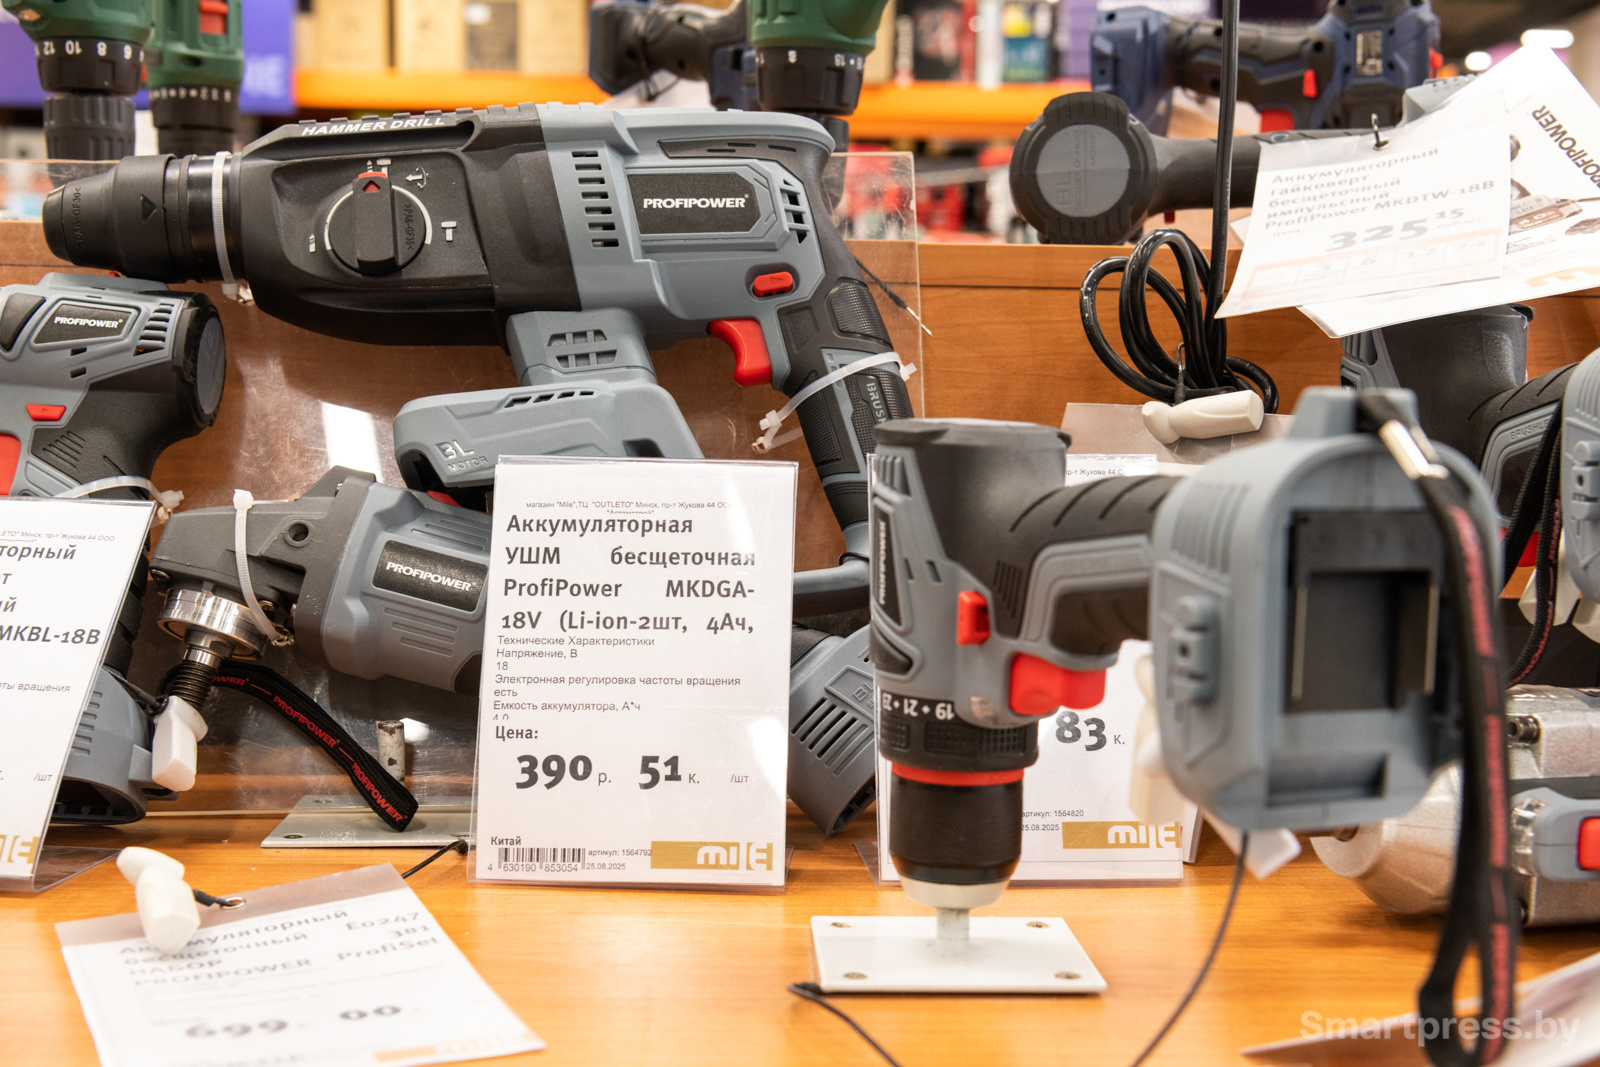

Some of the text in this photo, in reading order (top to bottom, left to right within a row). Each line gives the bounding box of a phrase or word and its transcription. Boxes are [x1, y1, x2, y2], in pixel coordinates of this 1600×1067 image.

[65, 40, 82, 55] 10
[97, 41, 108, 57] 8
[301, 117, 446, 136] HAMMER DRILL
[1272, 147, 1440, 185] Аккумуляторный
[1268, 178, 1401, 208] бесщеточный
[1270, 175, 1368, 197] гайковерт
[643, 197, 746, 209] PROFIPOWER
[1266, 192, 1390, 219] импульсный
[1265, 207, 1369, 230] ProfiPower
[1434, 208, 1465, 220] 15
[1325, 218, 1429, 252] 325
[54, 316, 118, 328] PROFIPOWER
[436, 440, 475, 461] BL
[447, 456, 489, 472] MOTOR
[1079, 468, 1106, 476] Жукова
[636, 502, 660, 510] Минск,
[678, 502, 705, 510] Жукова
[506, 514, 693, 538] Аккумуляторная
[505, 546, 756, 569] УШМ бесщеточная
[386, 561, 472, 591] PROFIPOWER
[503, 578, 755, 598] ProfiPower MKDGA-
[501, 609, 755, 635] 18V (Li-ion-2шт, 4Ач,
[498, 635, 655, 649] Технические Характеристики
[496, 648, 567, 660] Напряжение,
[496, 661, 509, 671] 18
[17, 683, 71, 692] вращения
[495, 674, 741, 688] Электронная регулировка частоты вращения
[494, 689, 518, 697] есть
[493, 701, 538, 711] Емкость
[541, 703, 619, 714] аккумулятора,
[903, 698, 919, 717] 21
[935, 703, 955, 720] 19
[273, 695, 337, 748] PROFIPOWER
[495, 725, 539, 740] Цена:
[1055, 711, 1126, 751] 83 к.
[33, 772, 53, 781] /шт
[515, 755, 749, 790] 390 р. 51 к. /шт
[352, 762, 403, 822] PROFIPOWER
[1054, 809, 1084, 817] 1564820
[490, 836, 522, 846] Китай
[588, 850, 653, 858] артикул: 1564792
[502, 863, 537, 873] 630190
[544, 863, 579, 873] 853054
[185, 1018, 288, 1038] 699
